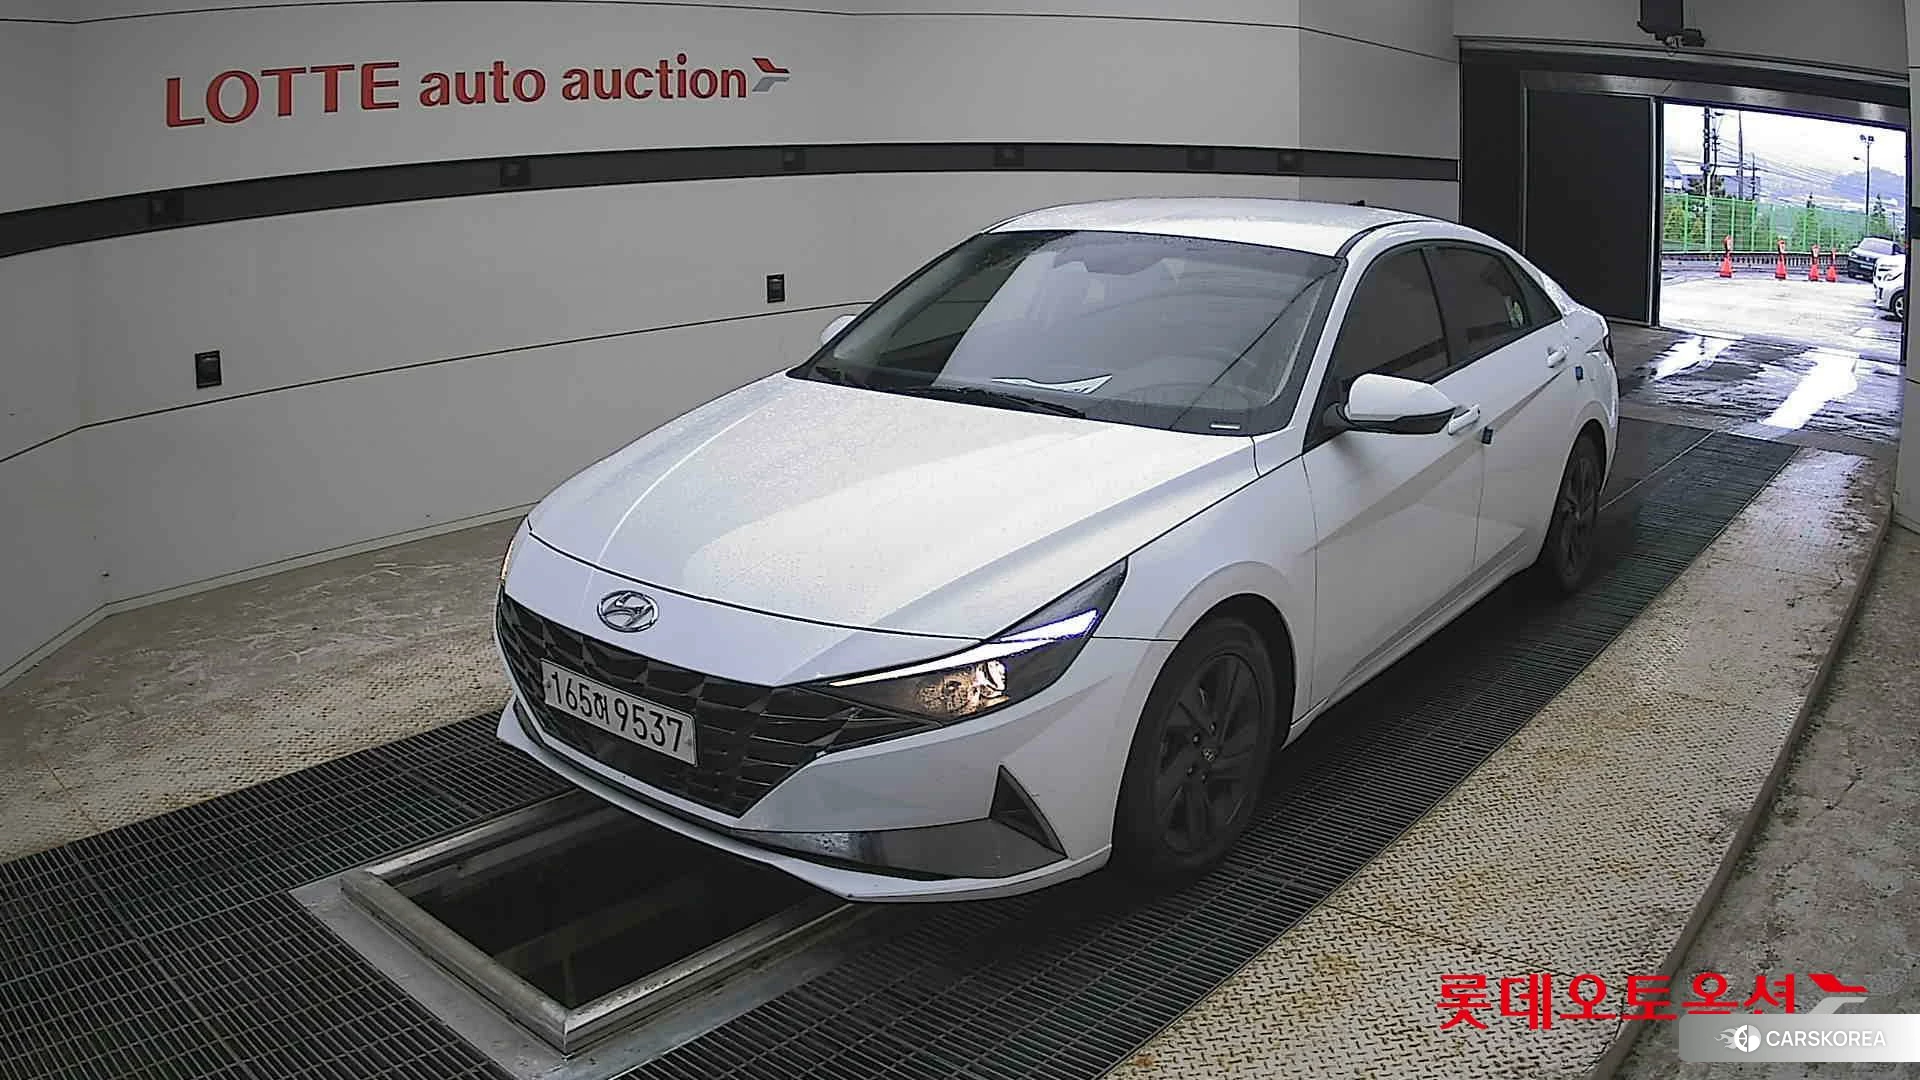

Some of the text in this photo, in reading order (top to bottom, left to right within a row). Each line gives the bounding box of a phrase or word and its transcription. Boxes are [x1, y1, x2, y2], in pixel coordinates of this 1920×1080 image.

[165, 52, 748, 127] LOTTE auto auction
[614, 697, 683, 752] 9537
